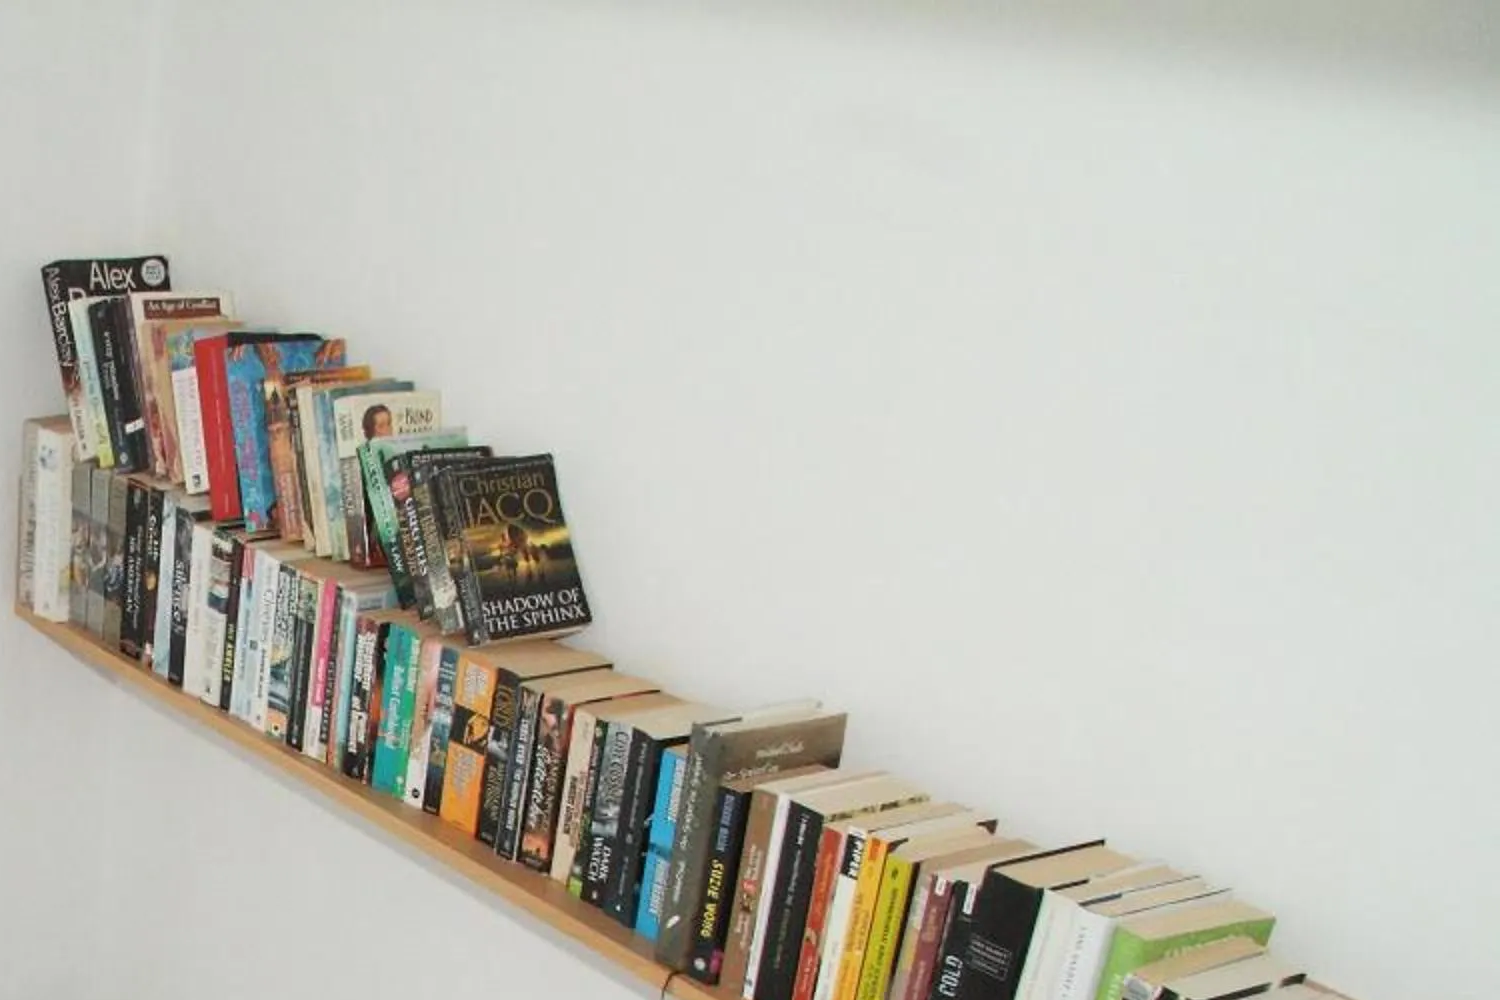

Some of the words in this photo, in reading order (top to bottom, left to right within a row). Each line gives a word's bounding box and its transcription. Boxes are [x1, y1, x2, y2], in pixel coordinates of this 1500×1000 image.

[89, 260, 137, 291] Alex
[460, 470, 546, 497] Christian
[463, 488, 556, 528] JACQ
[482, 594, 553, 618] SHADOW
[557, 587, 580, 606] OF
[484, 614, 521, 634] THE
[523, 605, 586, 627] SPHINX
[700, 903, 717, 938] WONG
